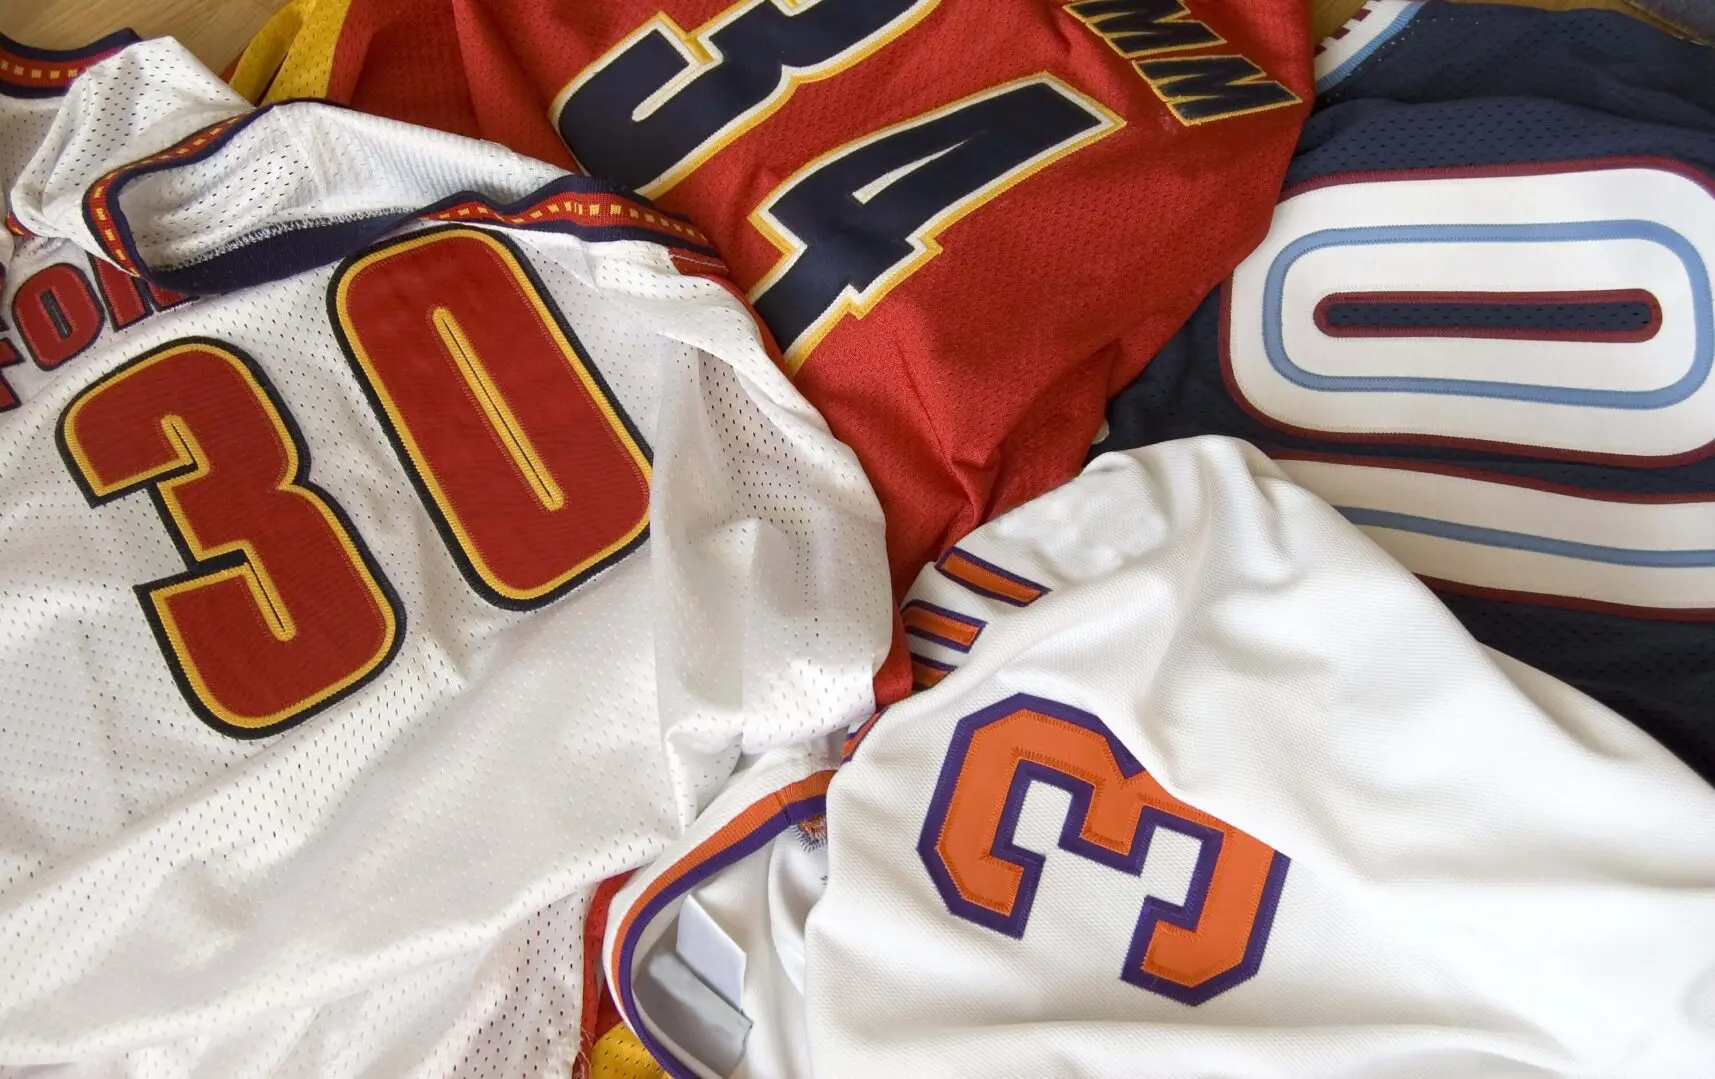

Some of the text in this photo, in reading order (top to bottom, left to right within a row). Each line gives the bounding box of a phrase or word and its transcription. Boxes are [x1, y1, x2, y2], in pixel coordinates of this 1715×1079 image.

[550, 0, 1127, 377] 34
[55, 224, 655, 740] 30
[917, 692, 1290, 1007] 3
